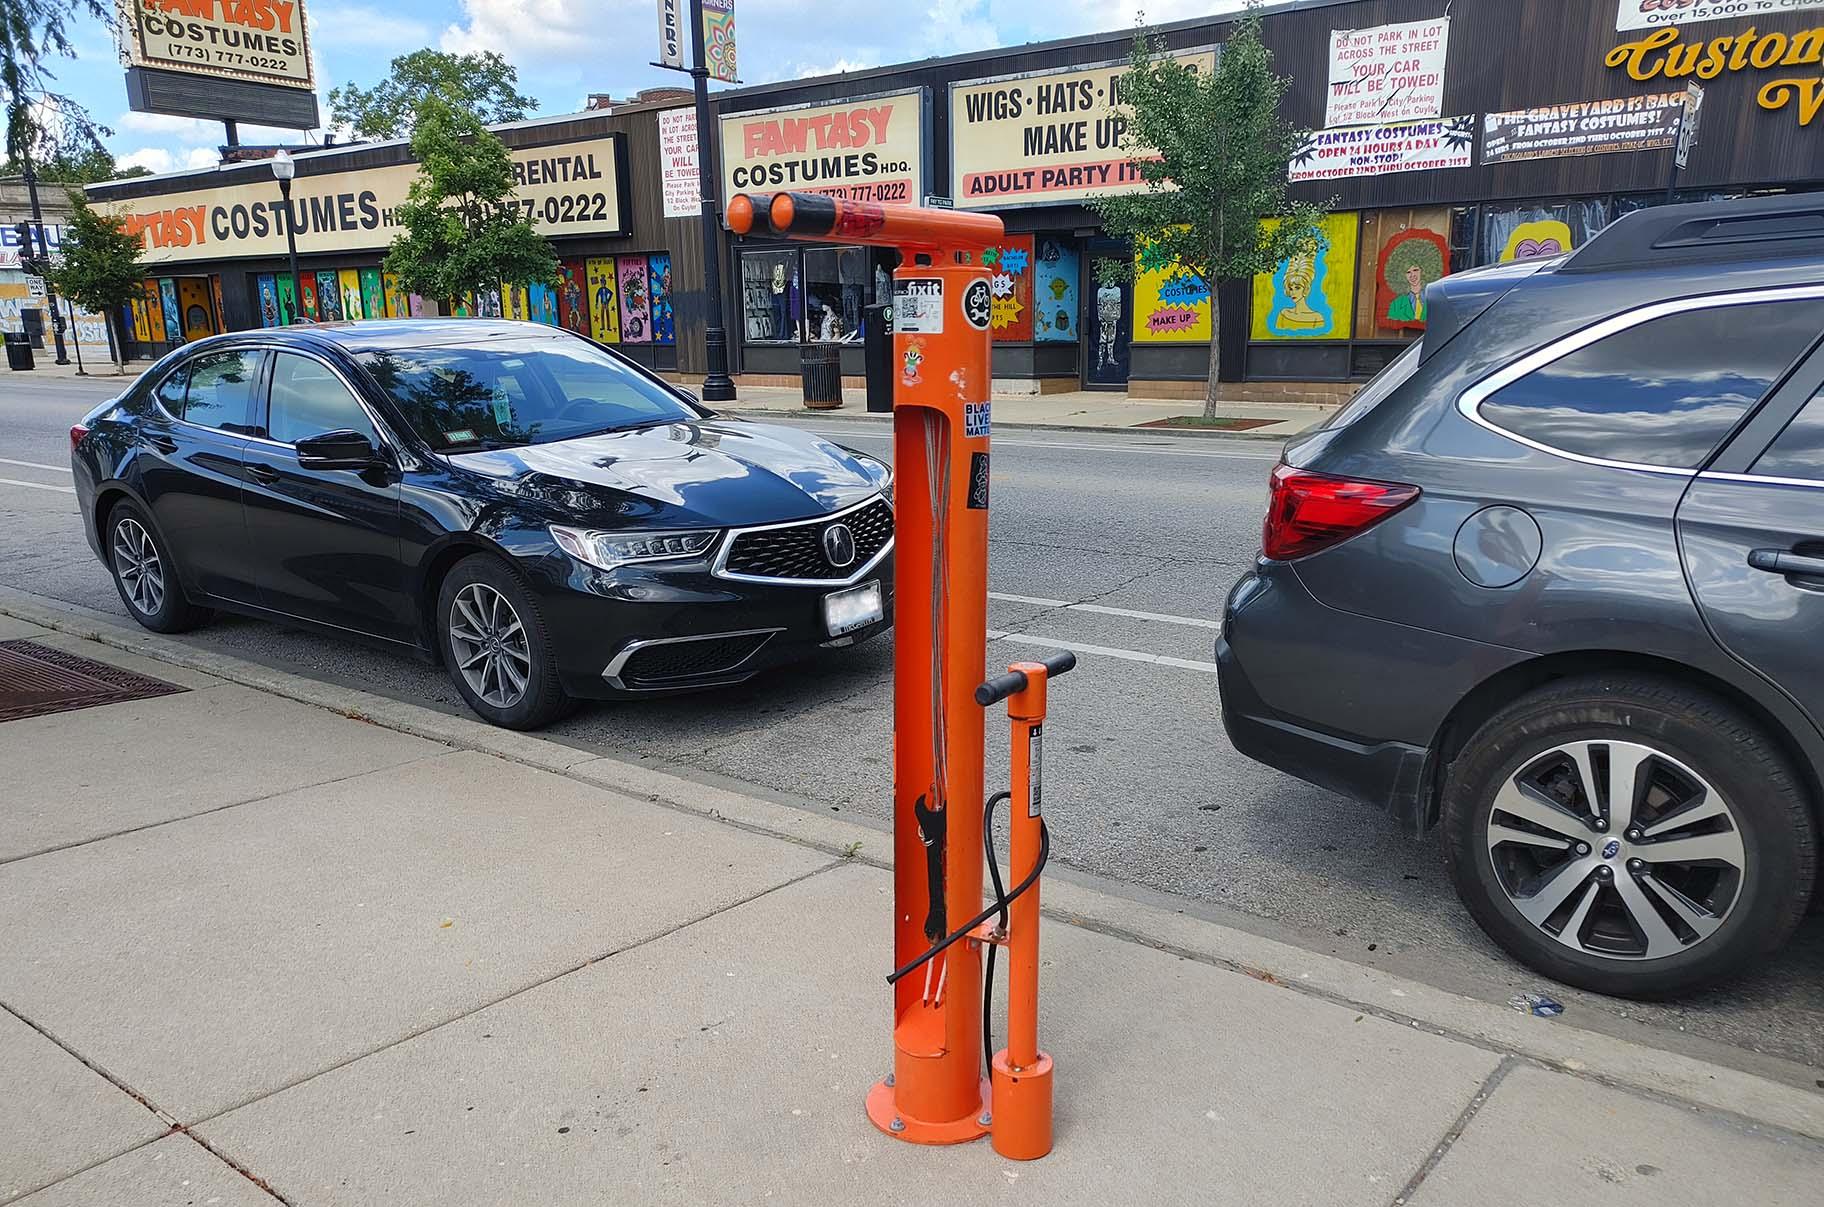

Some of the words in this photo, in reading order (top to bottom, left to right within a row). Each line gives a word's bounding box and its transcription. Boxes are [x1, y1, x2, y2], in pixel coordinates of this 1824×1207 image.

[1647, 13, 1685, 24] Over
[1691, 4, 1748, 18] 15,000
[1756, 1, 1773, 9] To
[144, 14, 298, 56] COSTUMES
[1336, 38, 1349, 48] DO
[1354, 35, 1373, 46] NOT
[1378, 31, 1403, 43] PARK
[1408, 29, 1418, 39] IN
[1423, 26, 1442, 37] LOT
[168, 43, 210, 62] (773)
[215, 50, 288, 71] 777-0222
[1337, 48, 1374, 61] ACROSS
[1380, 44, 1397, 56] THE
[1401, 40, 1439, 53] STREET
[1352, 63, 1385, 78] YOUR
[1394, 59, 1420, 73] CAR
[1333, 84, 1360, 96] WILL
[1367, 79, 1383, 92] BE
[1390, 73, 1439, 89] TOWED!
[966, 88, 1022, 123] WIGS
[1037, 80, 1093, 115] HATS
[1360, 99, 1376, 109] Park
[1407, 94, 1435, 105] Parking
[1529, 99, 1625, 122] GRAVEYARD
[1627, 96, 1644, 112] IS
[672, 115, 683, 123] NOT
[685, 113, 697, 121] PAR
[1355, 109, 1376, 119] Block
[1380, 108, 1398, 118] West
[669, 126, 679, 134] LOT
[744, 105, 893, 159] FANTASY
[1518, 119, 1578, 137] FANTASY
[1580, 110, 1662, 130] COSTUMES!
[677, 133, 697, 143] STREET
[1024, 121, 1087, 156] MAKE
[1096, 116, 1127, 149] UP
[1318, 129, 1371, 146] FANTASY
[1375, 123, 1443, 141] COSTUMES
[1487, 136, 1506, 148] OPEN
[1512, 140, 1533, 150] FROM
[1534, 137, 1568, 147] OCTOBER
[1610, 129, 1646, 140] OCTOBER
[664, 145, 682, 155] YOUR
[1318, 147, 1347, 159] OPEN
[1363, 141, 1403, 154] HOURS
[1406, 140, 1412, 150] A
[1415, 137, 1439, 149] DAY
[672, 156, 693, 168] WILL
[1316, 167, 1354, 178] OCTOBER
[1377, 162, 1403, 174] THRU
[1405, 160, 1446, 171] OCTOBER
[1350, 153, 1404, 166] NON-STOP!
[512, 154, 602, 186] RENTAL
[664, 169, 674, 178] BE
[733, 152, 878, 188] COSTUMES
[881, 161, 911, 174] HDQ.
[971, 171, 1035, 195] ADULT
[1042, 164, 1110, 188] PARTY
[851, 182, 905, 202] 777-0222
[212, 190, 379, 241] COSTUMES
[29, 278, 43, 286] ONE
[907, 281, 941, 296] fixit
[993, 280, 1006, 288] GS
[1165, 285, 1208, 298] COSTUMES
[1153, 315, 1177, 326] MAKE
[1180, 313, 1191, 323] UP
[965, 403, 991, 415] BLAC
[965, 414, 990, 427] LIVE
[966, 425, 990, 436] MATTE
